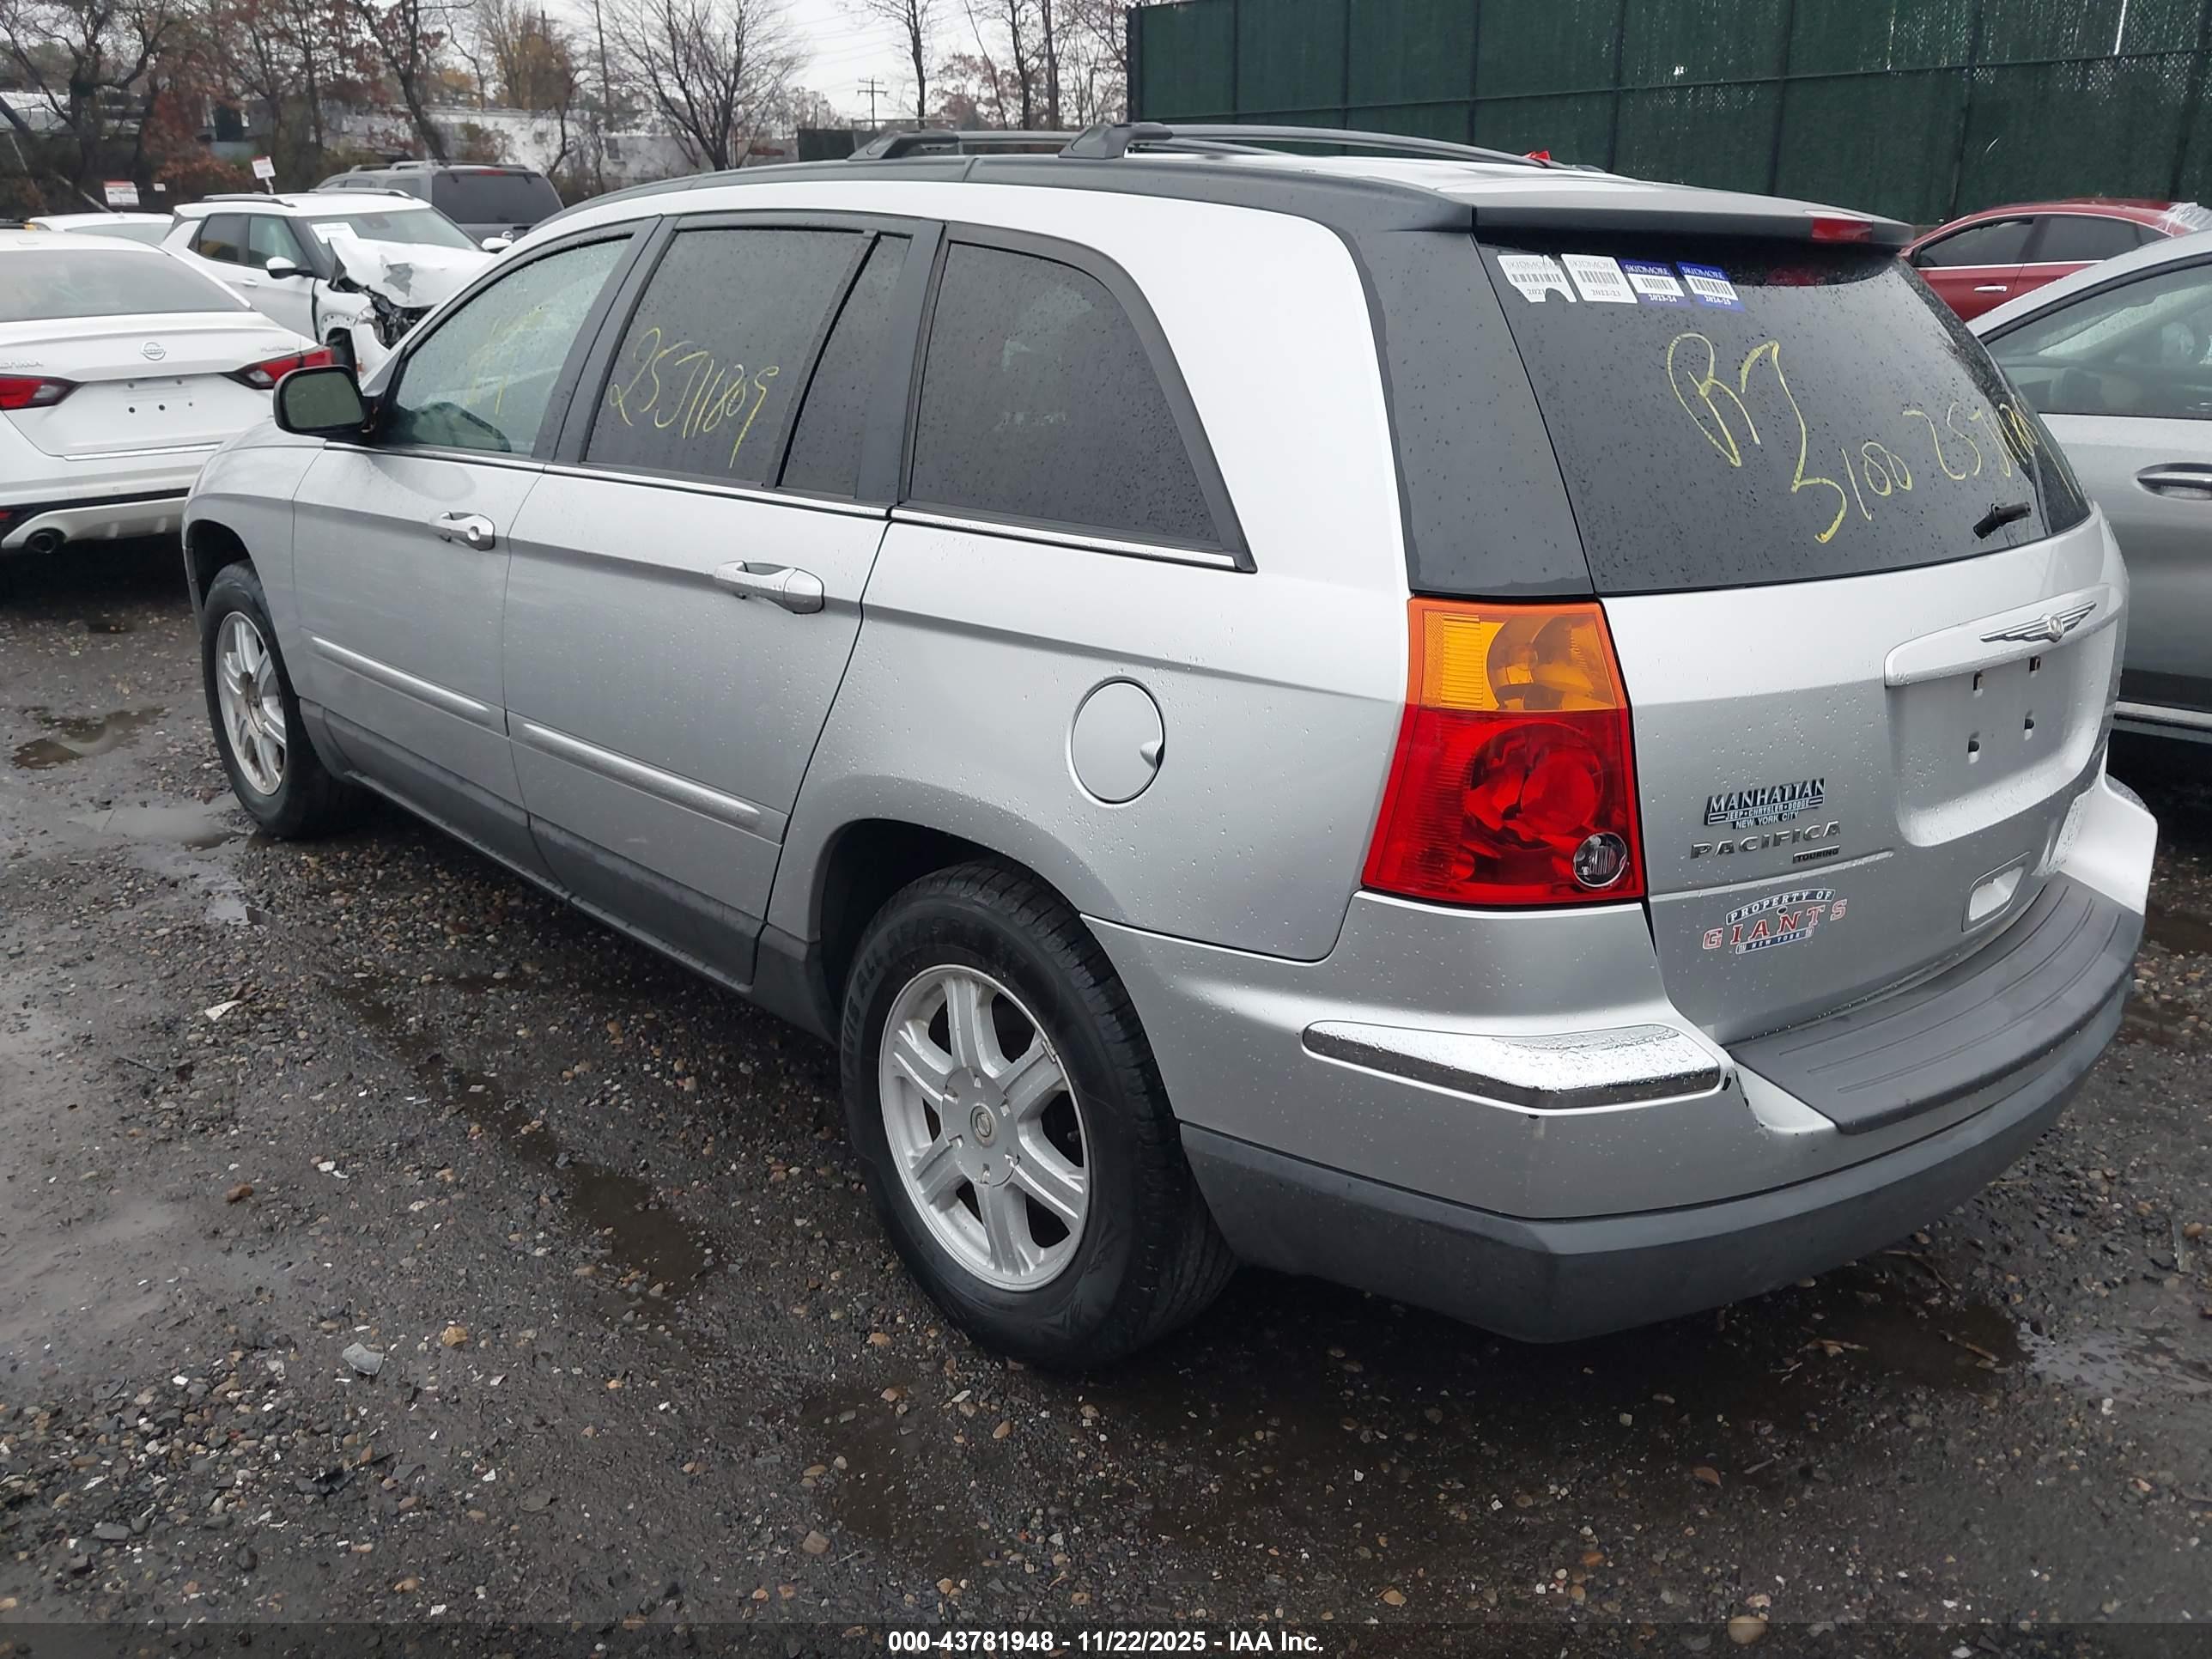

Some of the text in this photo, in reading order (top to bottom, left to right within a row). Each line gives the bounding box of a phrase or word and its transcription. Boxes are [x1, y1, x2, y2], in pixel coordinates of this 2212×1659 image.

[1625, 263, 1670, 276] SKIDMORE
[1707, 779, 1826, 812] MANHATTAN
[1725, 799, 1810, 821] JEEP CHRYSLER DODGE
[1735, 811, 1800, 830] NEW YORK CITY
[1690, 820, 1841, 860] PACIFICA
[1796, 847, 1840, 863] TOURING
[1729, 890, 1832, 922] PROPERTY OF
[1702, 898, 1848, 950] GIANTS
[1751, 939, 1772, 949] NEW
[1777, 932, 1801, 943] YORK
